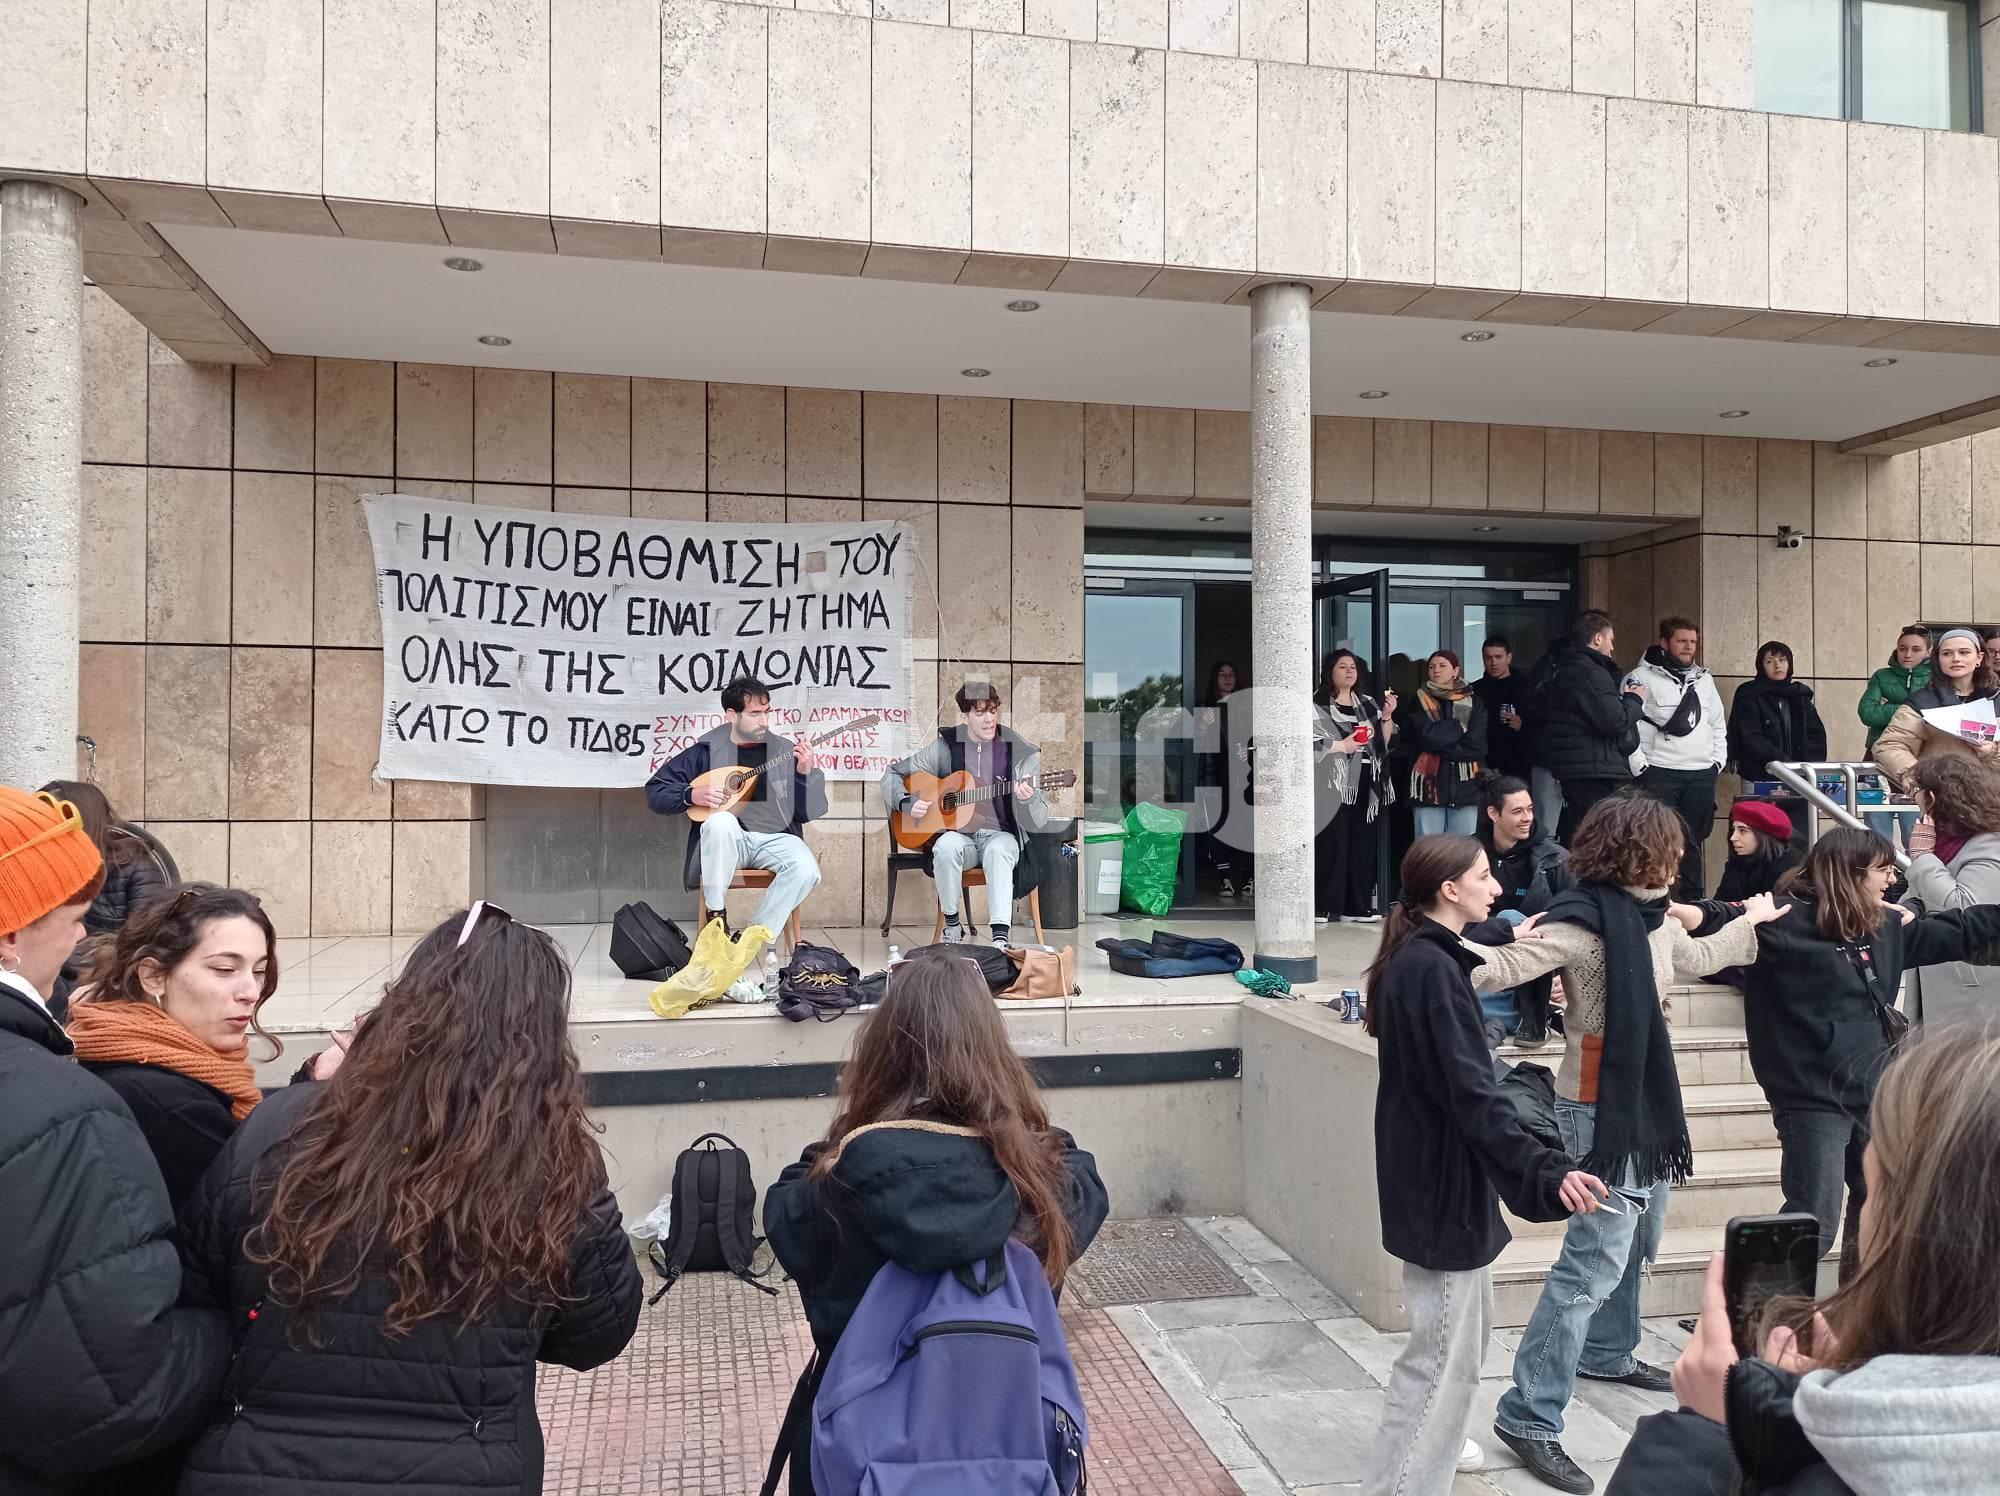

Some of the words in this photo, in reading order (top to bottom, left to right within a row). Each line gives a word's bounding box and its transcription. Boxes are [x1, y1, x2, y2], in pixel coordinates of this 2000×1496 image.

[422, 512, 452, 561] Η
[474, 518, 799, 588] ΥΠΟΒΑΘΜΙΣΗ
[830, 532, 902, 577] ΤΟΥ
[627, 596, 711, 636] ΕΙΝΑΙ
[736, 589, 890, 636] ΖΗΤΗΜΑ
[401, 635, 516, 687] ΟΛΗΣ
[538, 648, 626, 695] ΤΗΣ
[658, 645, 891, 695] ΚΟΙΝΩΝΙΑΣ
[389, 701, 490, 743] ΚΑΤΩ
[498, 710, 548, 747] ΤΟ
[568, 717, 651, 756] ΠΔ85
